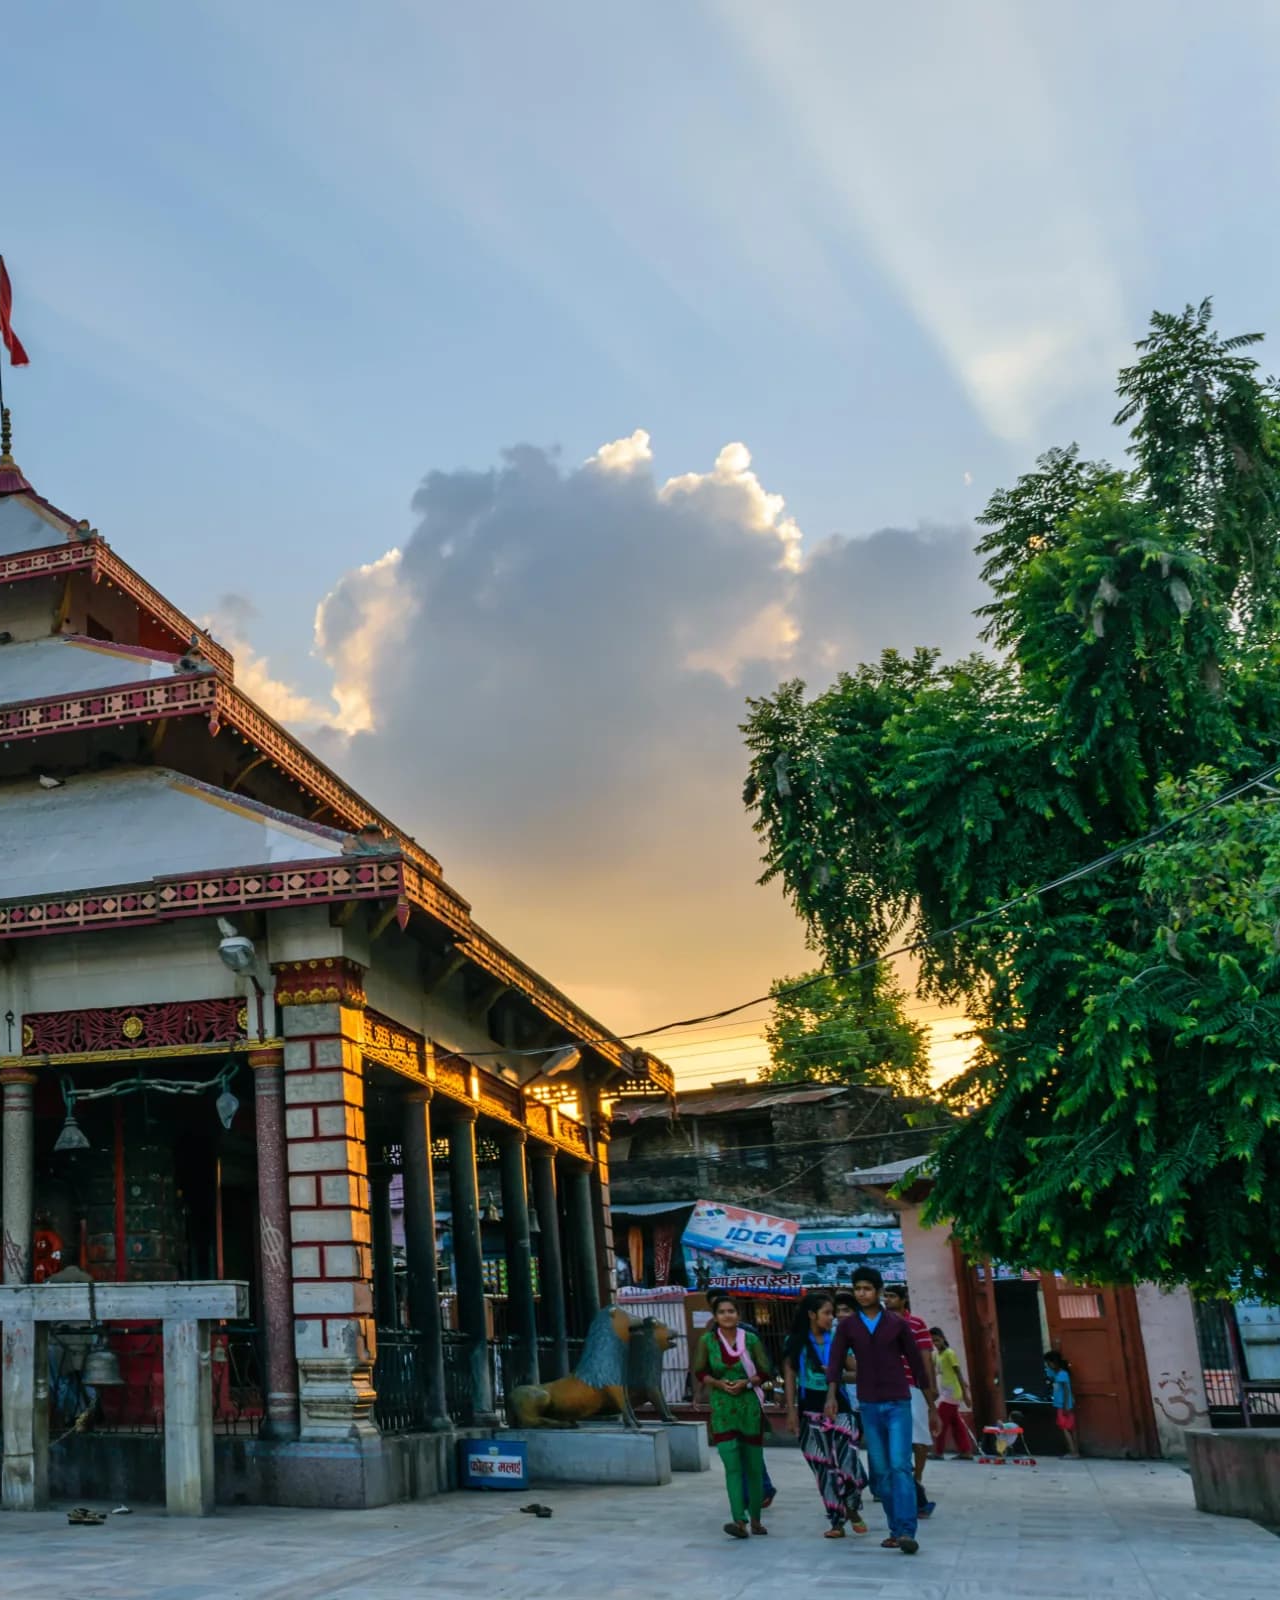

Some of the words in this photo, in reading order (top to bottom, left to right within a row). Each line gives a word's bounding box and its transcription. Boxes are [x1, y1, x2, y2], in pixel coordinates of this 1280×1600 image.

[725, 1227, 787, 1247] IDEA
[768, 1272, 801, 1285] स्टोर
[497, 1460, 521, 1475] मलाई
